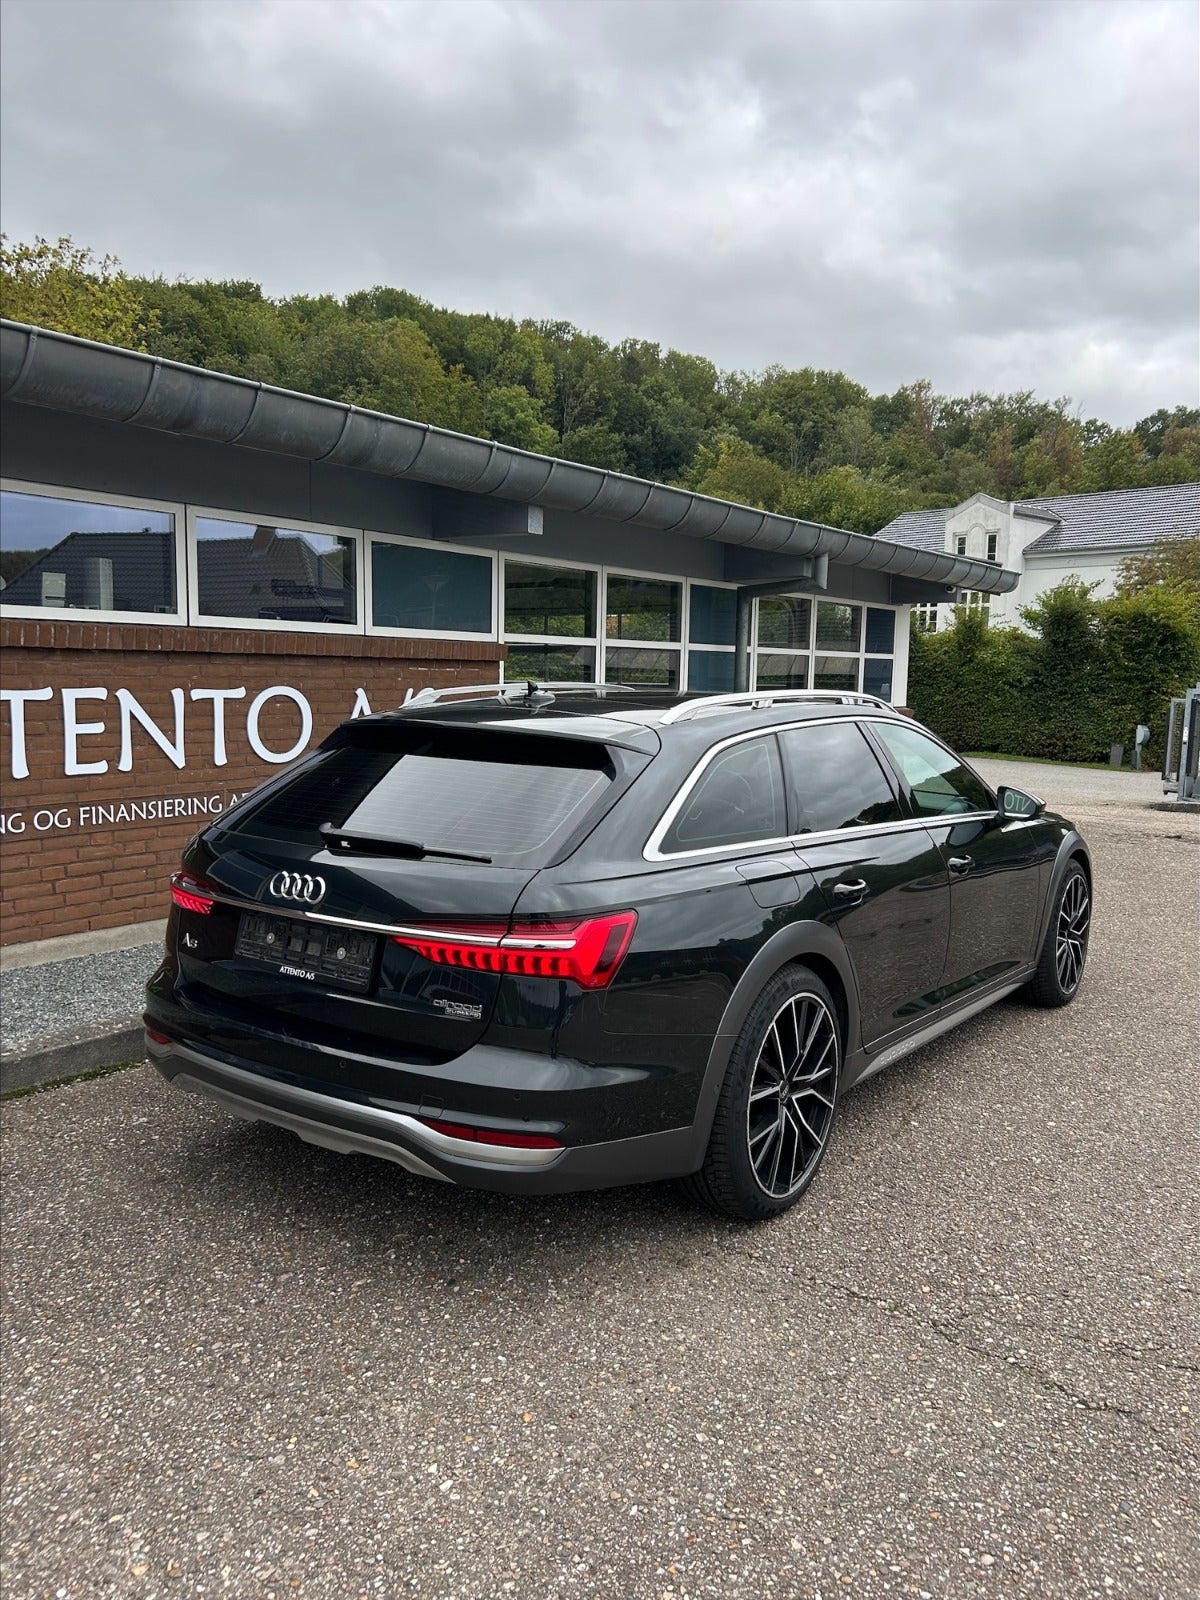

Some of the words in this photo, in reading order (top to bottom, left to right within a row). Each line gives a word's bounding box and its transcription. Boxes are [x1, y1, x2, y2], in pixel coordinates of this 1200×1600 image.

[0, 684, 313, 779] TENTO
[33, 808, 72, 831] OG
[78, 794, 223, 827] FINANSIERING
[279, 965, 306, 978] ATTENTO
